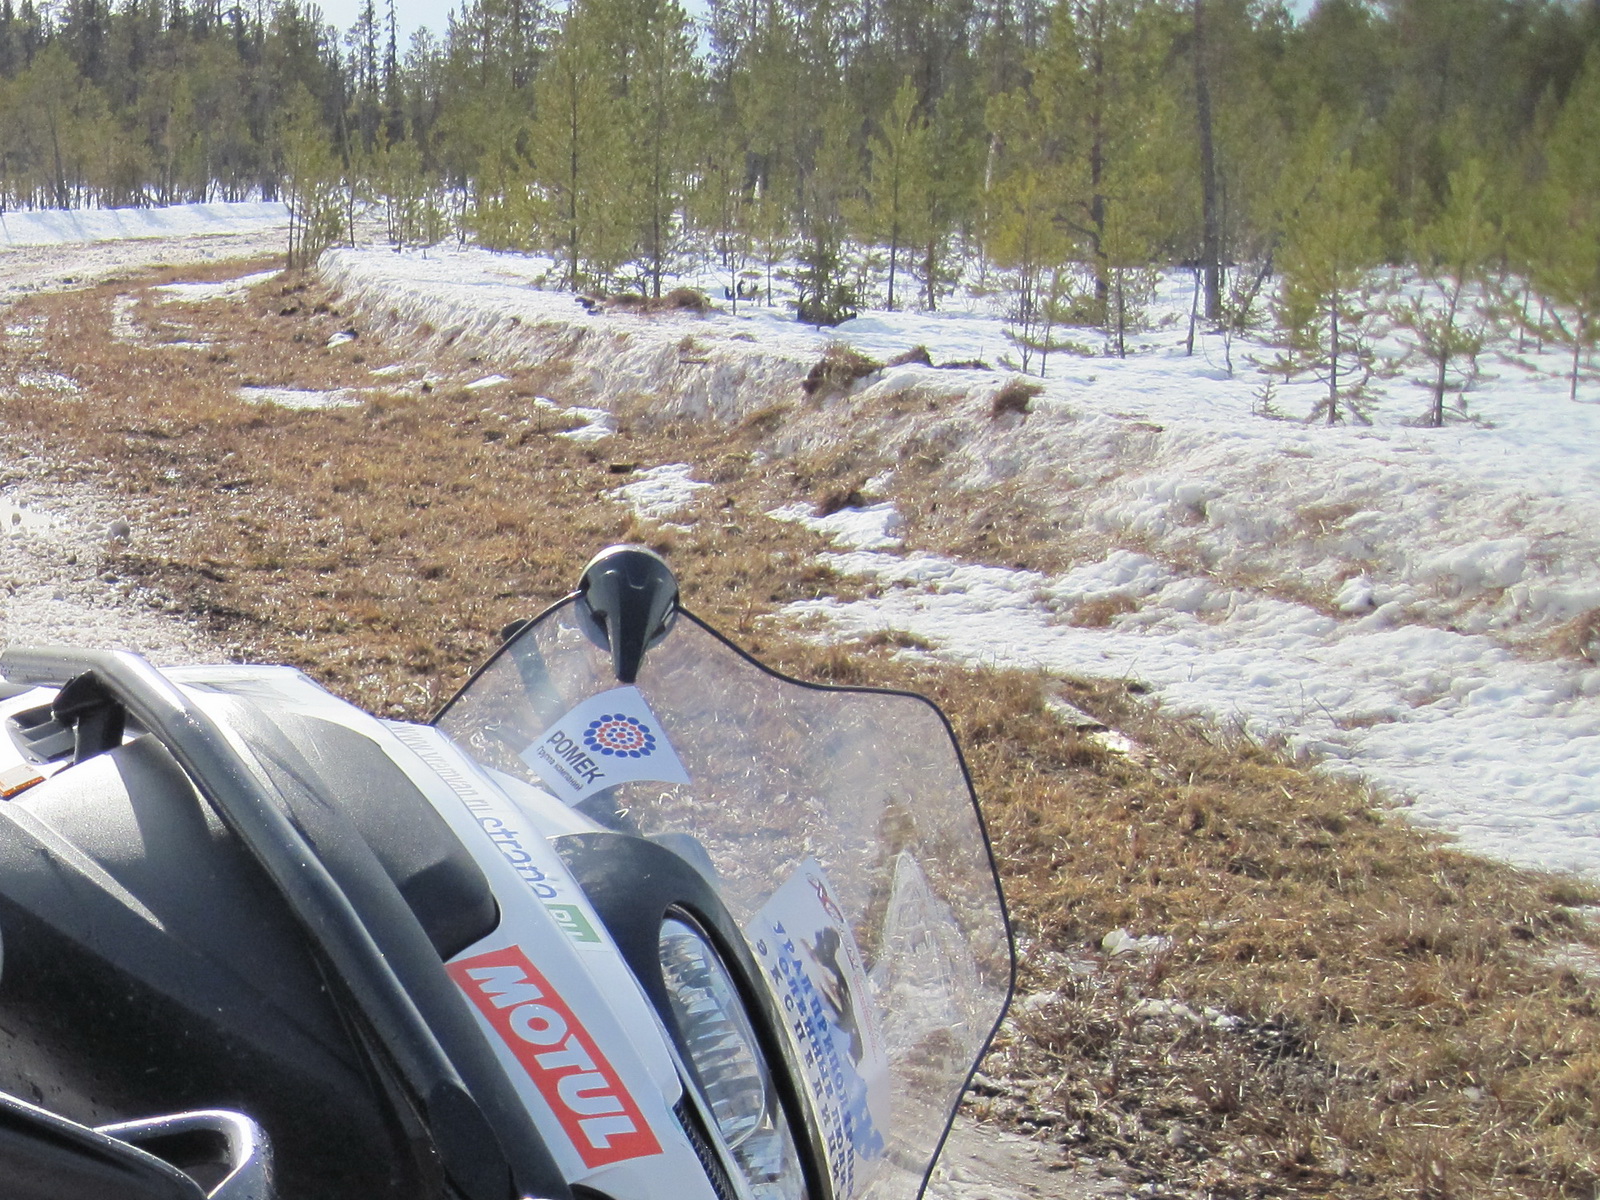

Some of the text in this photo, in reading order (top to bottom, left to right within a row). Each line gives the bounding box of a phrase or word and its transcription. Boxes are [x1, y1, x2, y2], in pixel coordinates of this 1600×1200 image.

[537, 745, 584, 792] Группа компаний
[546, 729, 606, 785] РОМЕК
[773, 919, 814, 995] УРАЛ
[465, 965, 638, 1150] MOTUL
